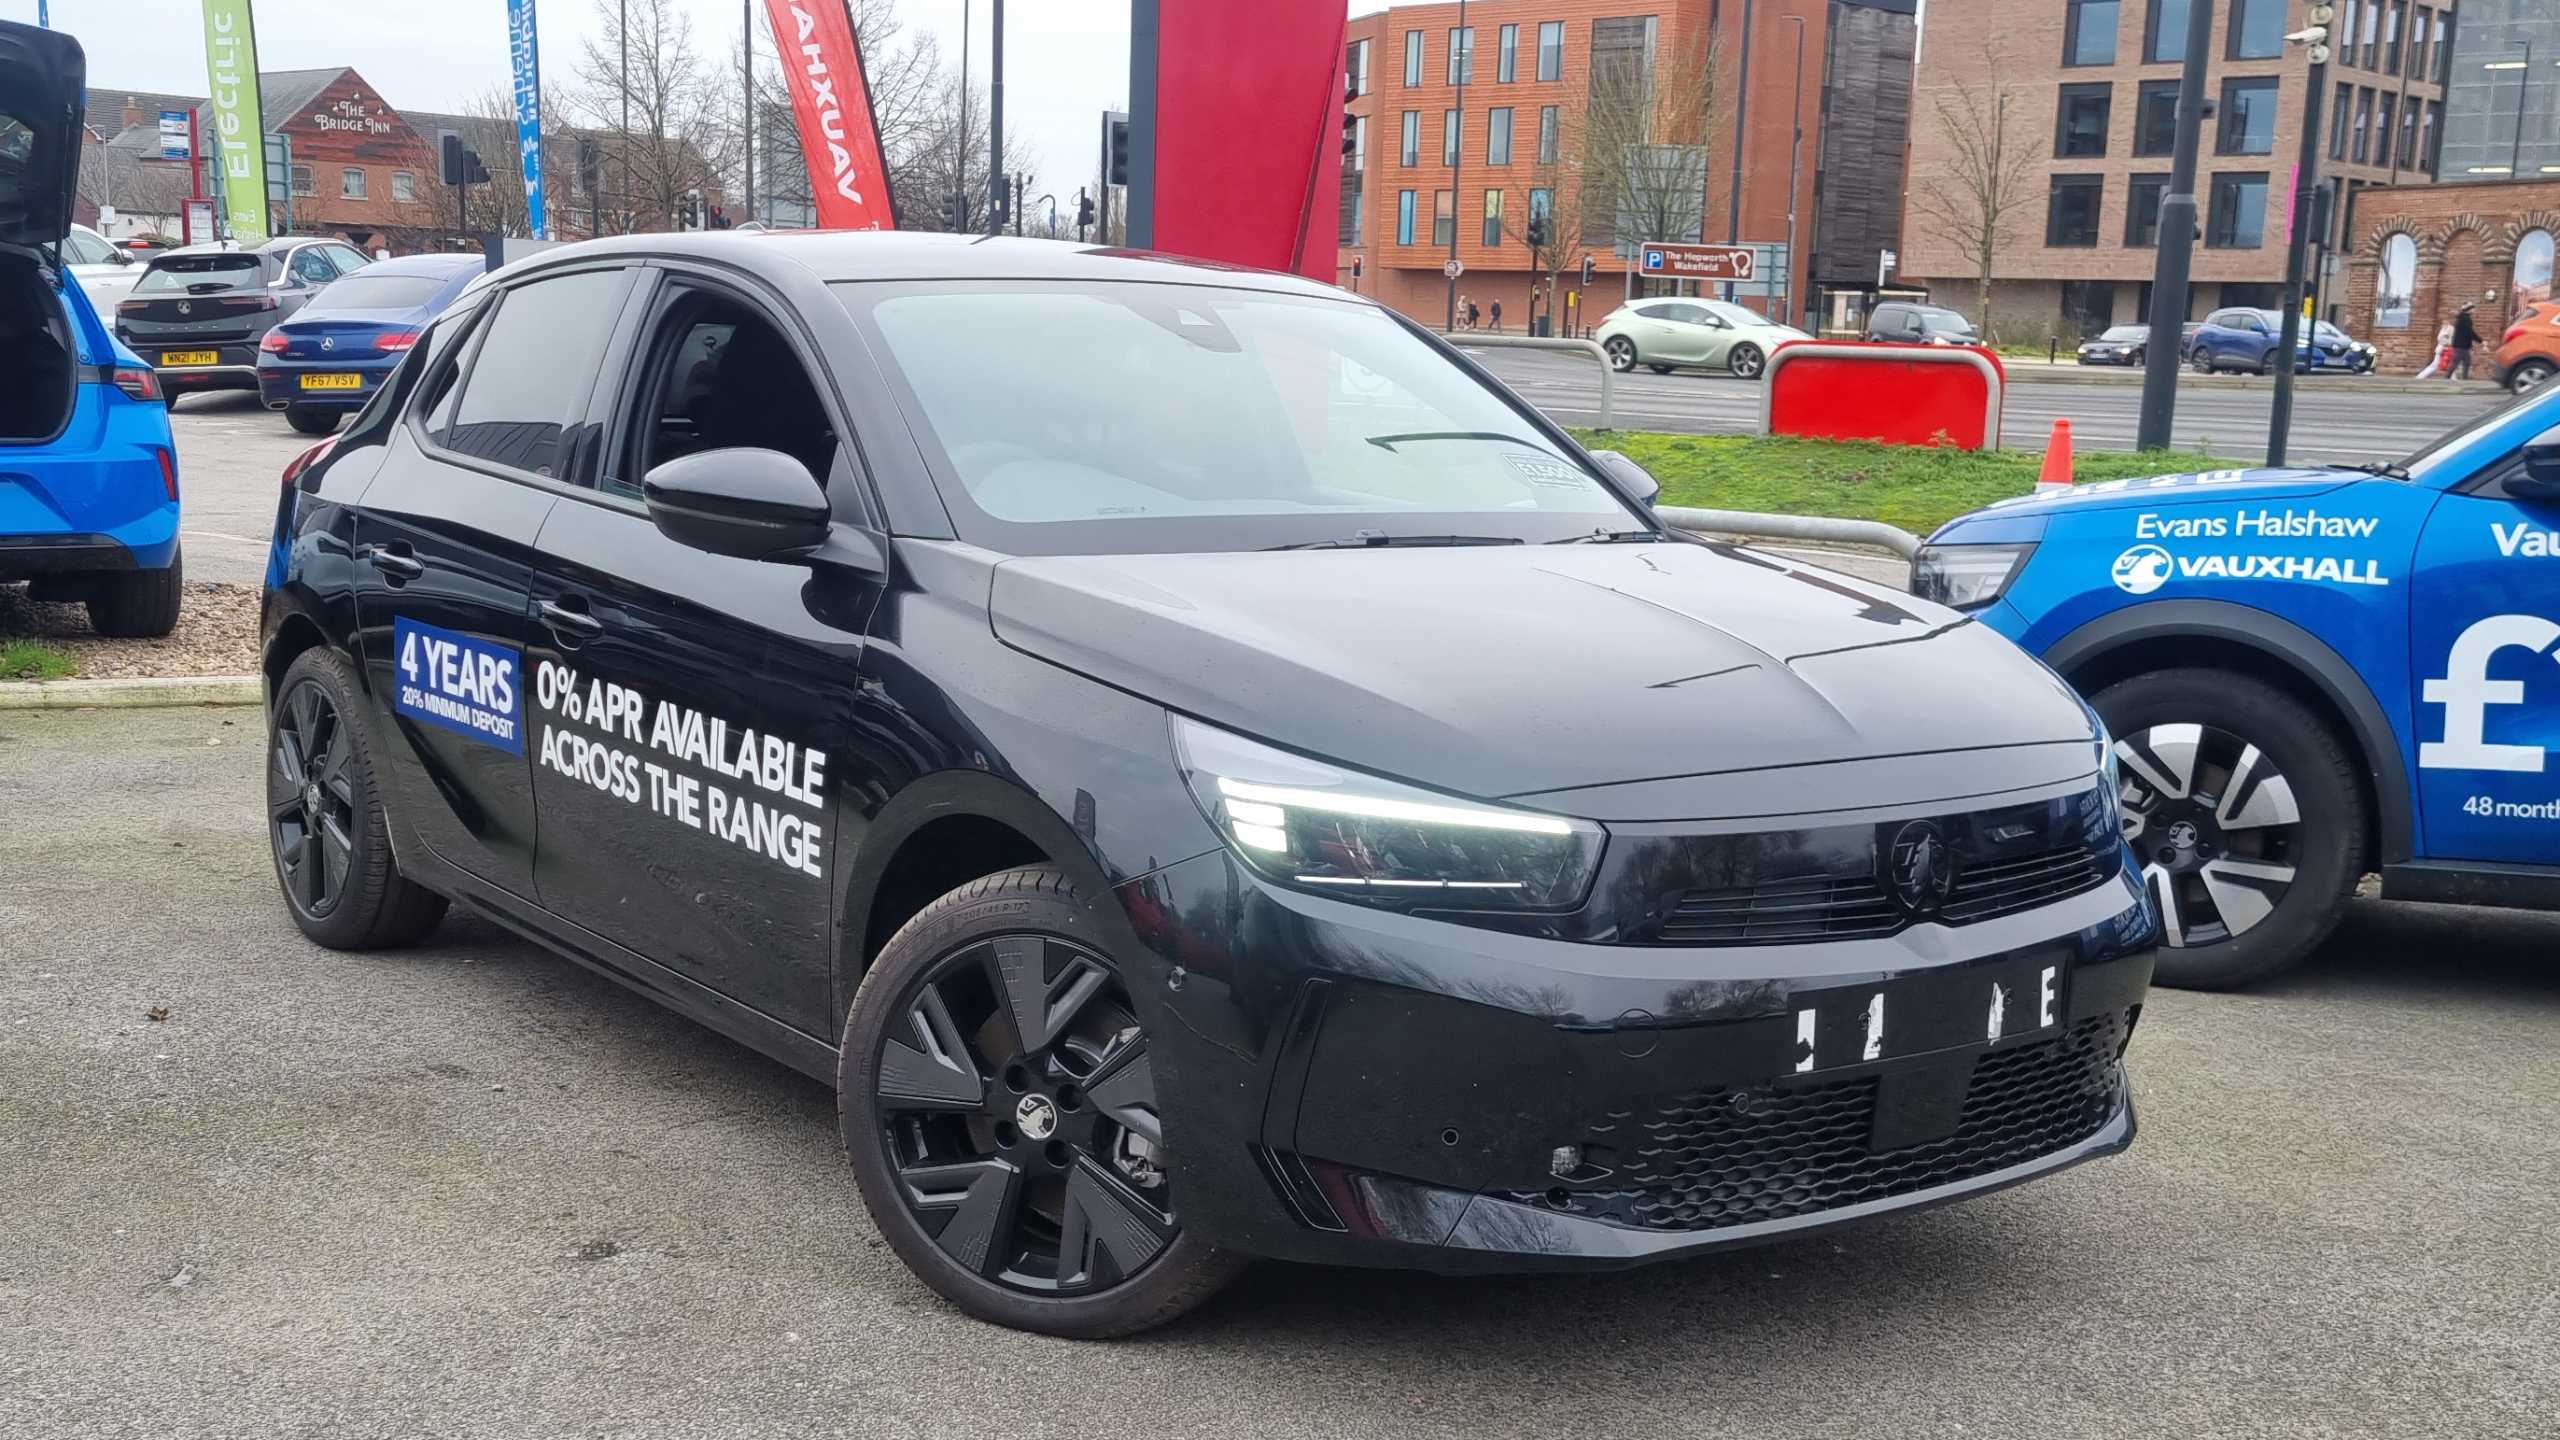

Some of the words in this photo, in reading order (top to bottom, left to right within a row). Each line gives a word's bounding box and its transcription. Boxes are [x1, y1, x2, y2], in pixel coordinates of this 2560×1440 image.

[340, 101, 365, 118] THE
[314, 114, 364, 131] BRIDGE
[365, 117, 390, 135] INN
[1649, 252, 1661, 268] P
[1665, 250, 1681, 260] The
[1684, 252, 1729, 263] Hepworth
[1674, 261, 1719, 272] Wakefield
[304, 375, 331, 386] YF67
[334, 375, 355, 386] VSV
[2136, 513, 2227, 539] Evans
[2235, 510, 2379, 538] Halshaw
[2177, 556, 2389, 585] VAUXHALL
[401, 631, 418, 682] 4
[422, 636, 513, 715] YEARS
[402, 685, 424, 709] 20%
[424, 692, 471, 726] MINIMUM
[471, 708, 514, 740] DEPOSIT
[537, 660, 582, 721] 0%
[585, 678, 643, 744] APR
[650, 700, 826, 809] AVAILABLE
[540, 724, 641, 803] ACROSS
[644, 761, 701, 829] THE
[708, 786, 821, 878] RANGE
[2463, 796, 2493, 816] 48
